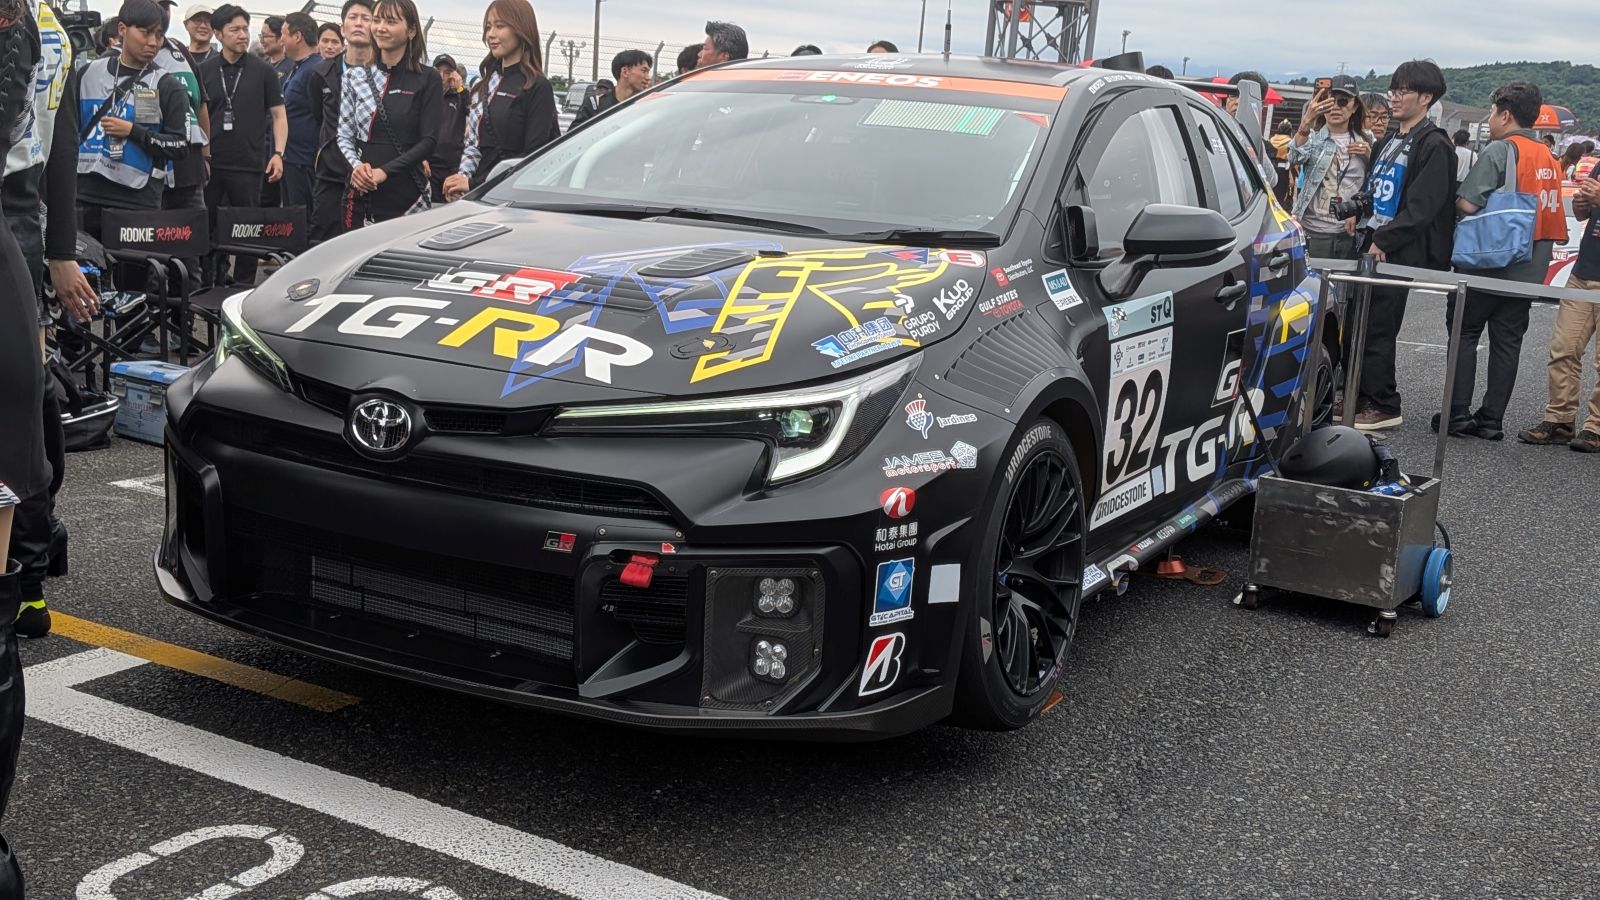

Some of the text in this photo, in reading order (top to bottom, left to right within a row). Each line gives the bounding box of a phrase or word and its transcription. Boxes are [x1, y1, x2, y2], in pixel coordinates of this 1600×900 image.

[805, 71, 943, 88] ENEOS
[120, 225, 192, 242] ROOKIE RACING
[231, 222, 294, 238] ROOKIE RACING
[428, 271, 556, 300] GR
[946, 287, 974, 320] GROUP
[979, 289, 1018, 312] GULF STATES
[904, 311, 936, 330] GRUPO
[285, 293, 654, 385] TG-RR
[909, 321, 941, 340] PURDY
[936, 413, 978, 428] Jardines
[1105, 368, 1163, 485] 32
[883, 450, 953, 470] JAMEEL
[1005, 425, 1052, 485] BRIDGESTONE
[1094, 481, 1147, 522] BRIDGESTONE
[875, 521, 919, 542] 和泰集團
[546, 538, 573, 550] GR
[874, 538, 917, 552] Hotai Group
[888, 571, 907, 588] GT
